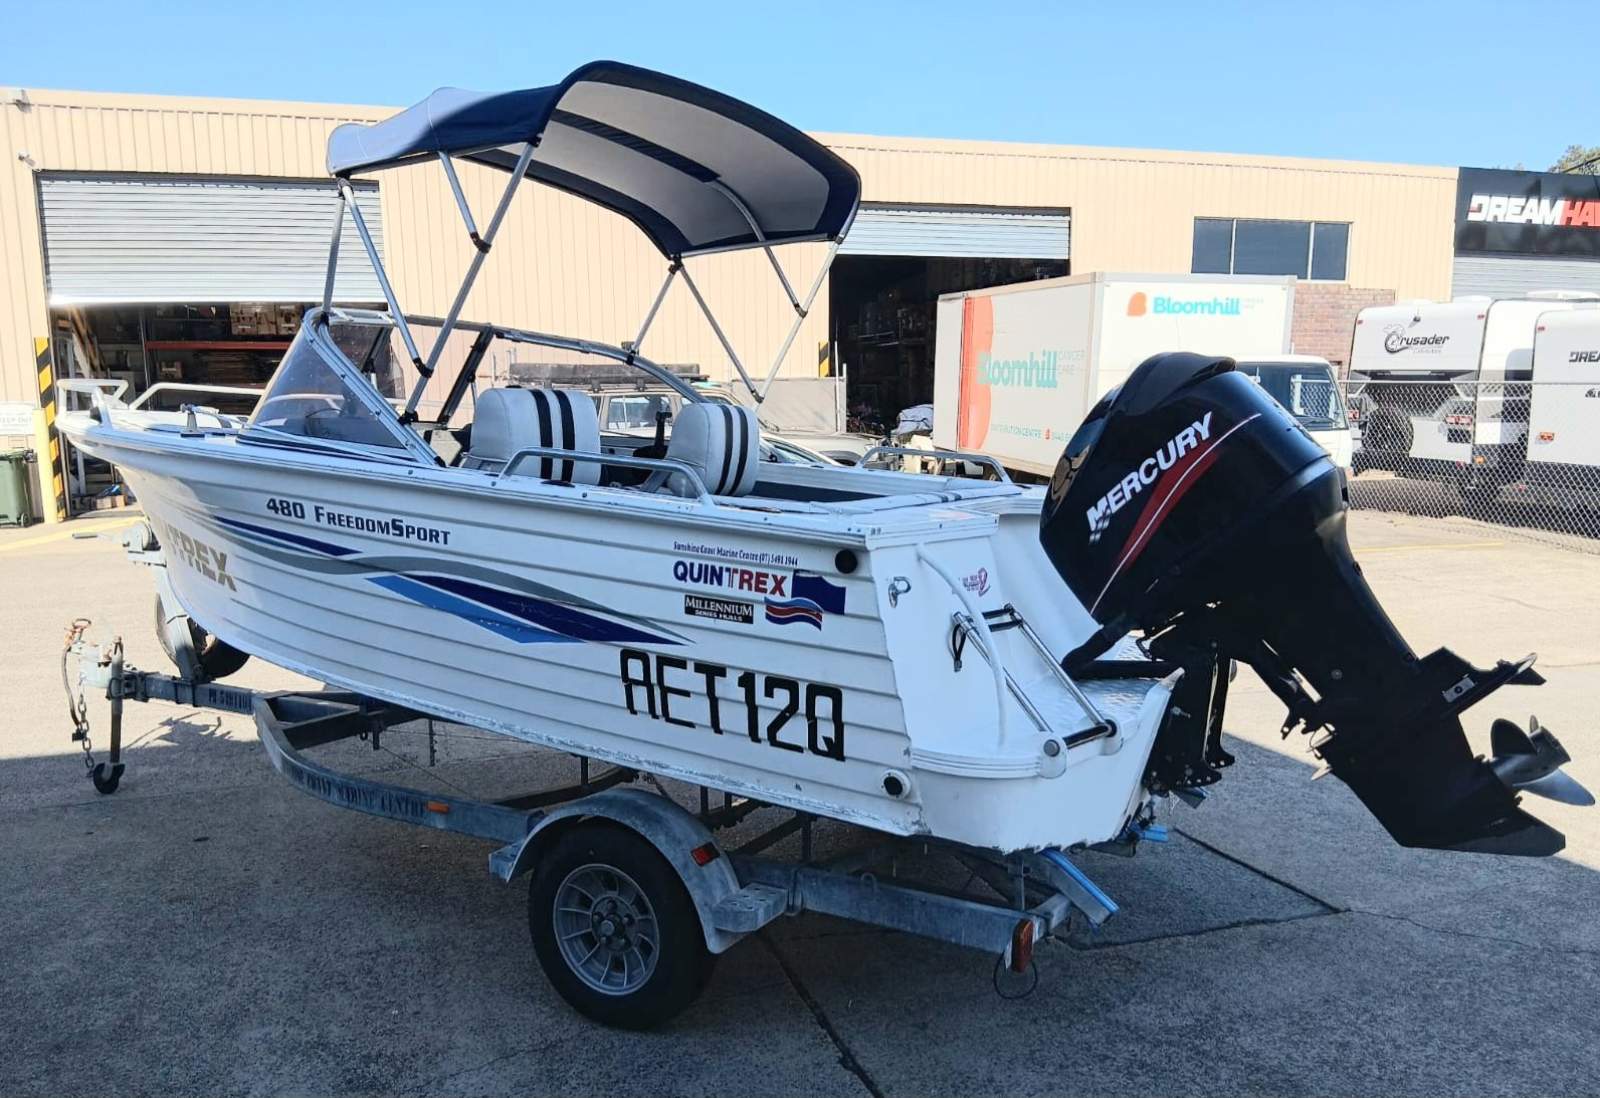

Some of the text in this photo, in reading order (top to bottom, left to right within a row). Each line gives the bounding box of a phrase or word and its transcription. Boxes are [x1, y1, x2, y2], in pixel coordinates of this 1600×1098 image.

[1467, 194, 1600, 227] DREAMHA
[1153, 297, 1241, 316] Bloomhill
[1384, 331, 1450, 354] Crusader
[976, 351, 1058, 388] Bloomhill
[1086, 411, 1212, 534] MERCURY
[266, 498, 305, 519] 480
[717, 547, 739, 558] Marine
[673, 560, 788, 597] QUINTREX
[685, 596, 753, 616] MILLENNIUM
